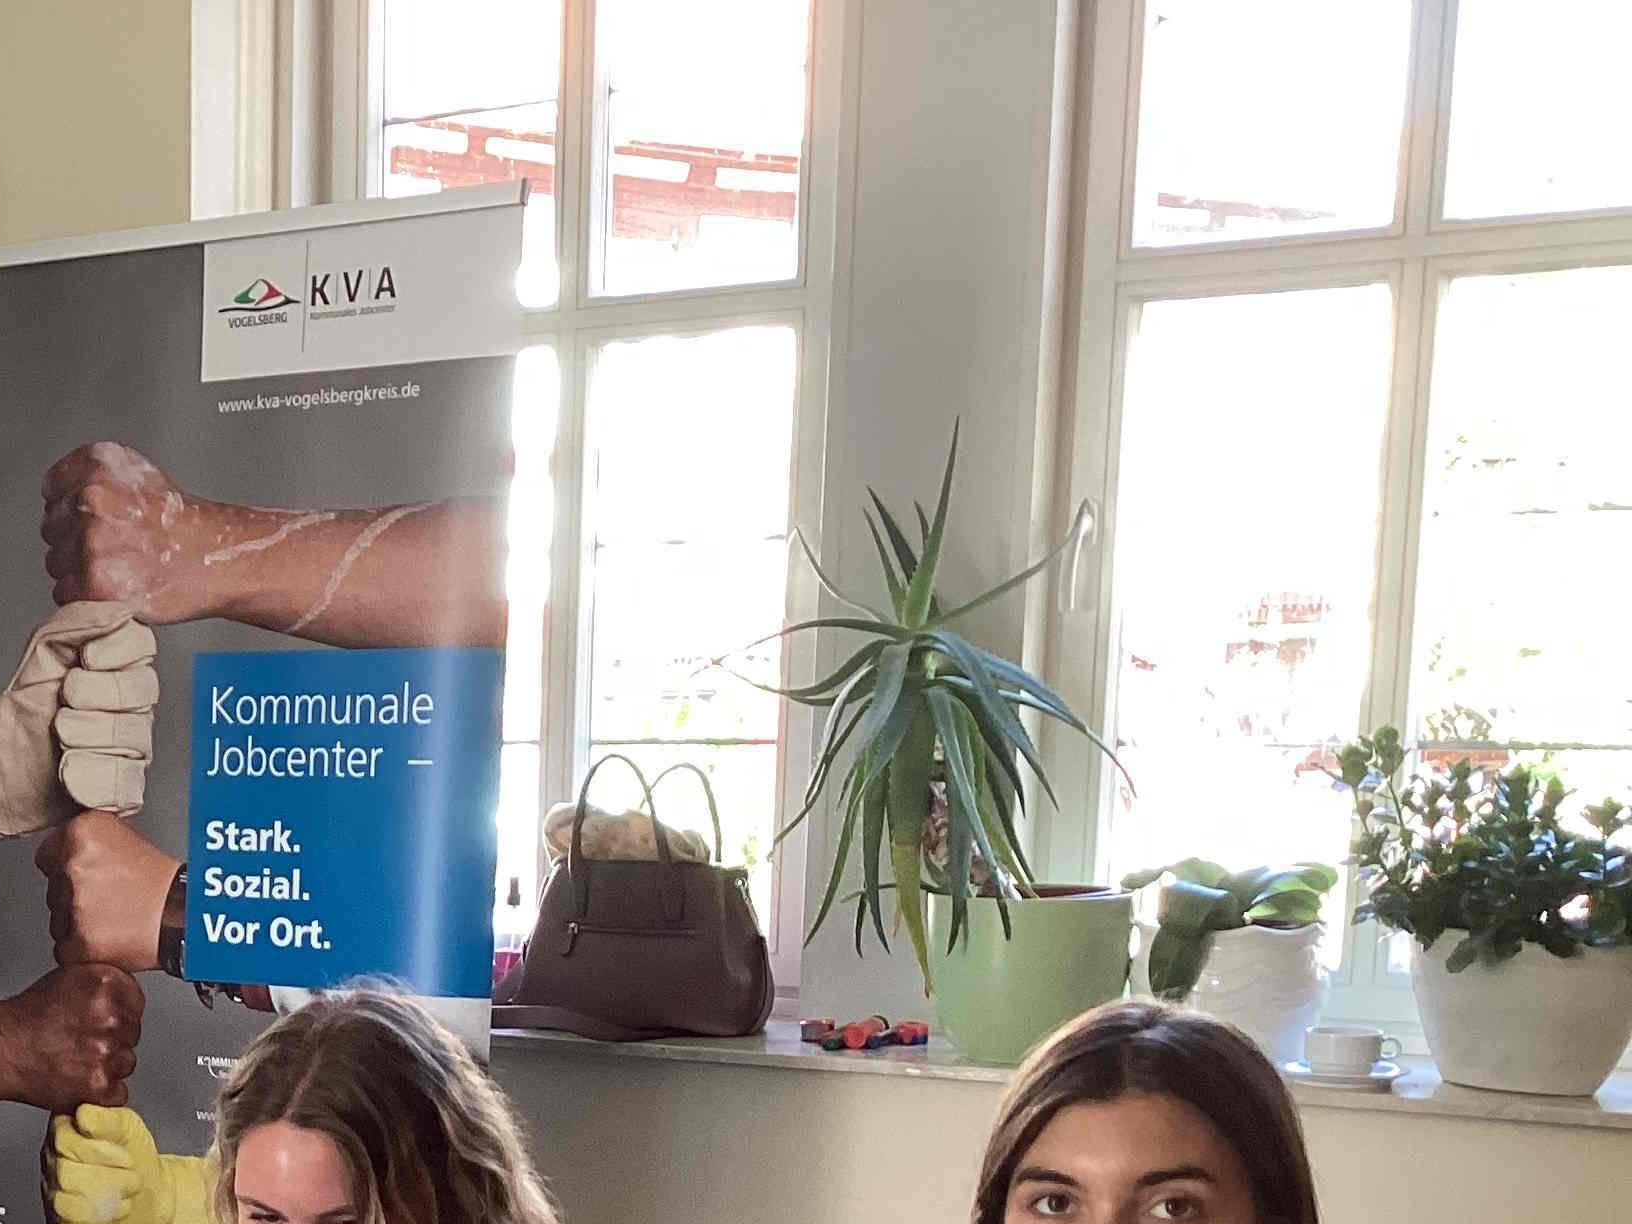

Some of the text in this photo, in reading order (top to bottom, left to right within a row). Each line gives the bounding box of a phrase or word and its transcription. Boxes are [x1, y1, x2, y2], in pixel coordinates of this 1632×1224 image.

[228, 312, 288, 329] VOGELSBERG
[218, 381, 421, 413] www.kva-vogelsbergkreis.de
[210, 682, 435, 726] Kommunale
[206, 736, 384, 778] Jobcenter
[205, 820, 301, 854] Stark.
[204, 867, 311, 901] Sozial.
[202, 913, 332, 950] Vor Ort.
